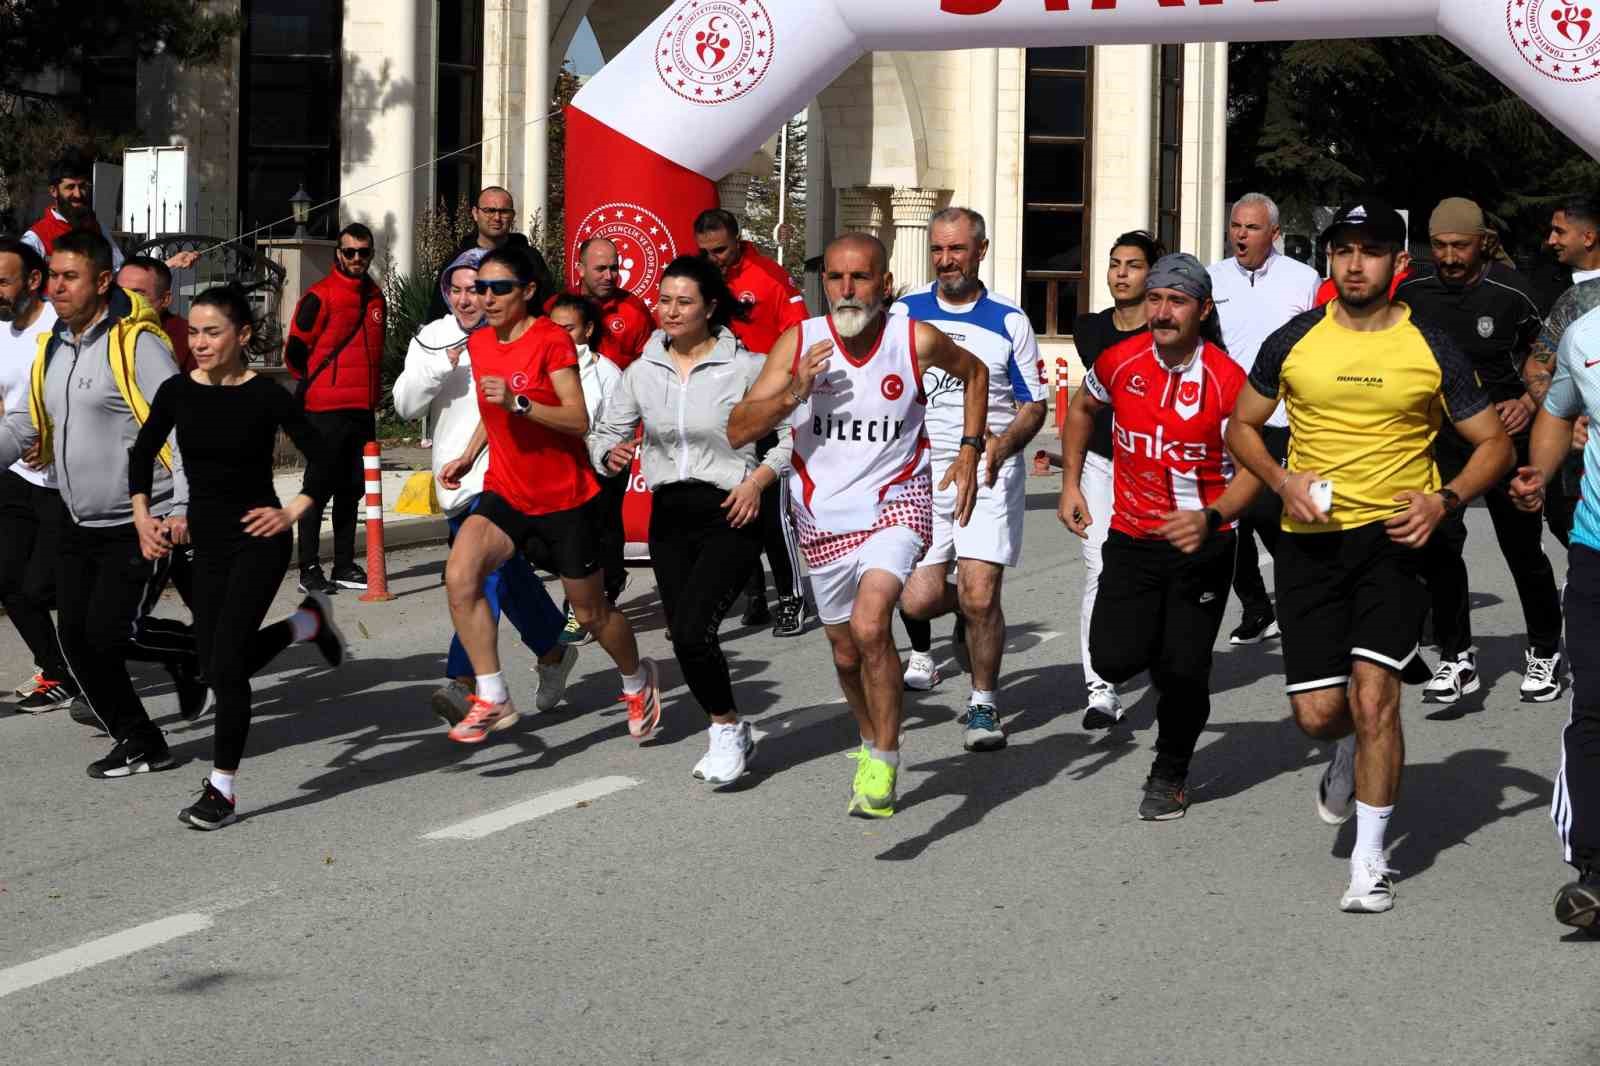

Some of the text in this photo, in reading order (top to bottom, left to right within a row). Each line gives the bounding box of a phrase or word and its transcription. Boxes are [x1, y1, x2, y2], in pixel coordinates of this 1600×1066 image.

[743, 30, 751, 50] SPOR
[607, 225, 641, 238] GENÇLİK
[645, 246, 655, 267] SPOR
[812, 413, 905, 442] BİLECİK
